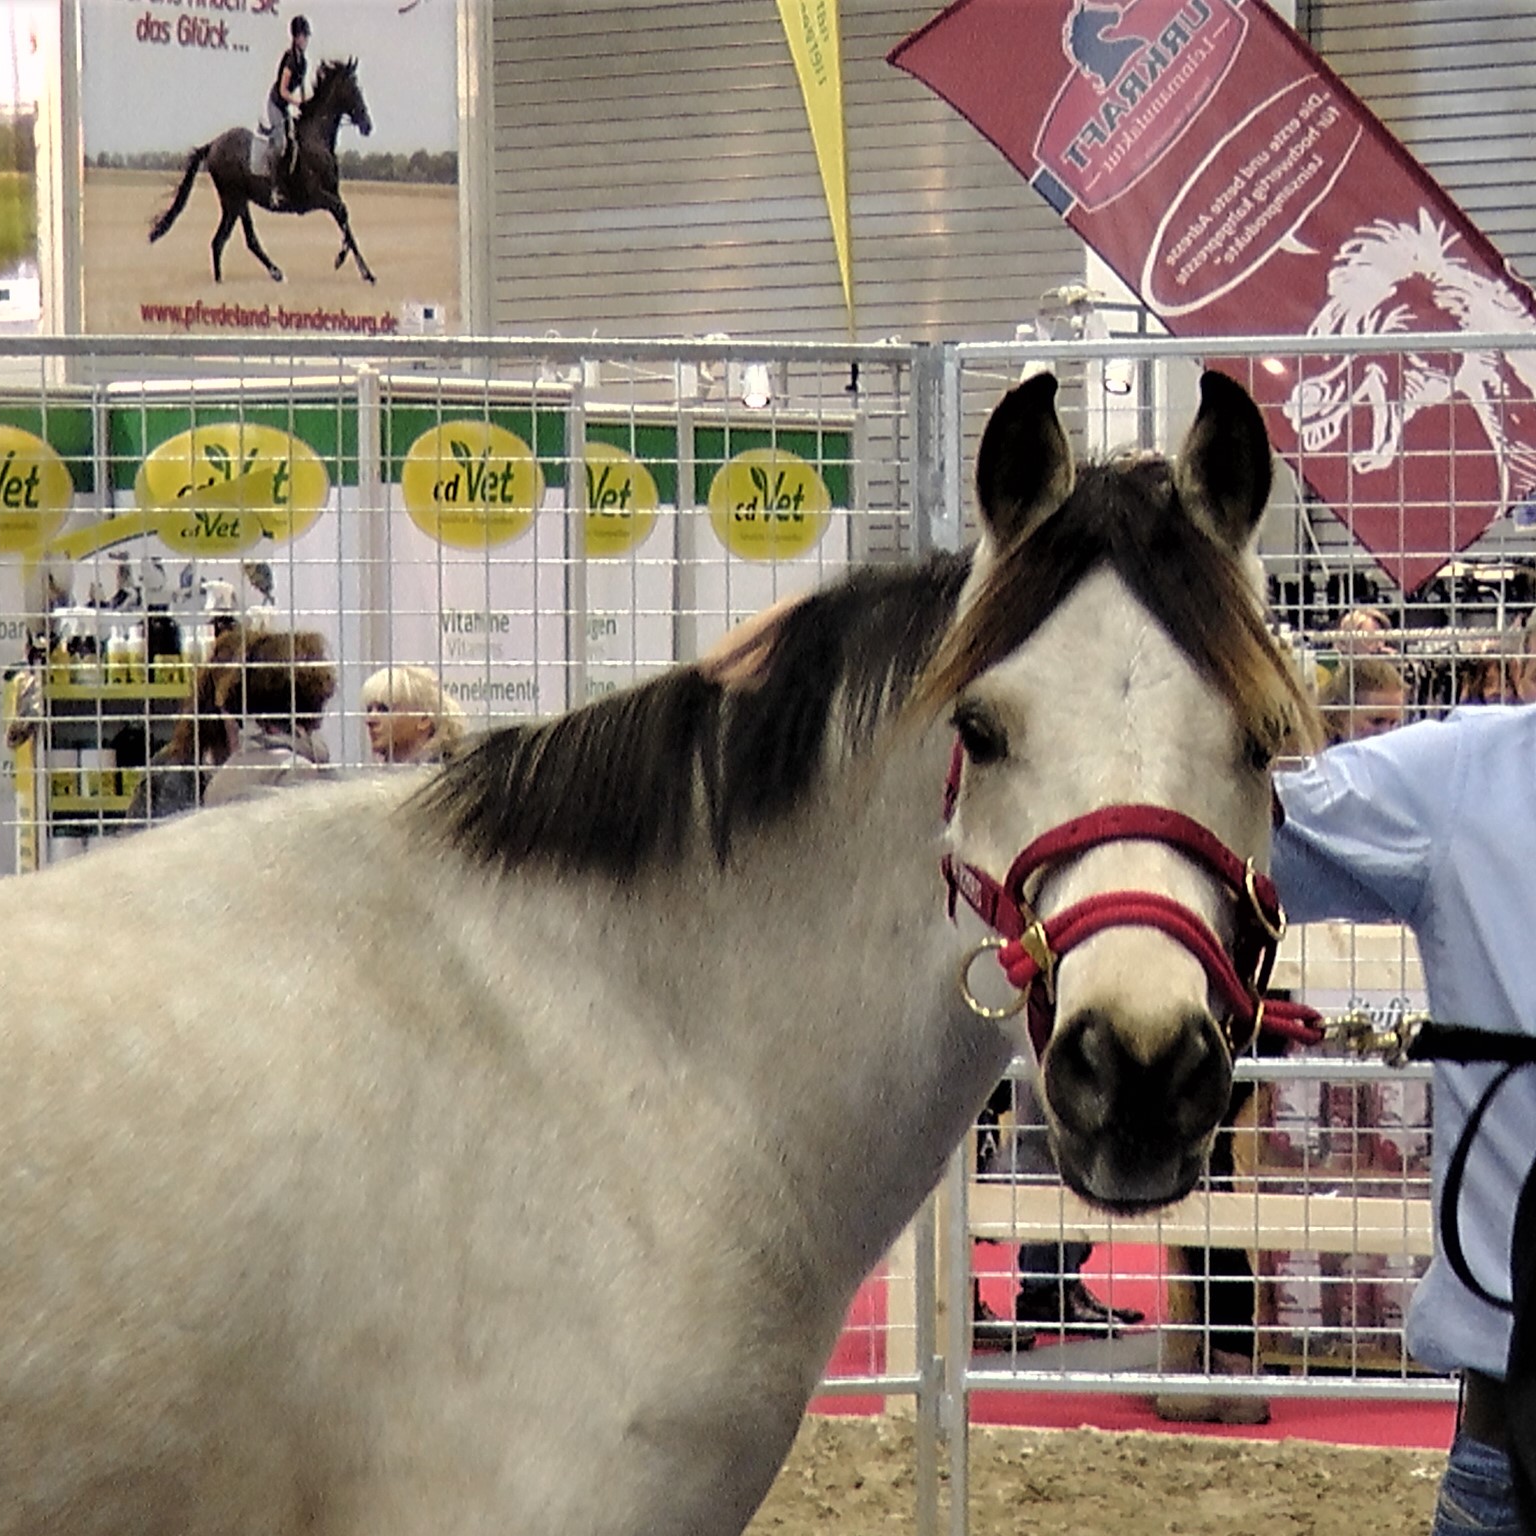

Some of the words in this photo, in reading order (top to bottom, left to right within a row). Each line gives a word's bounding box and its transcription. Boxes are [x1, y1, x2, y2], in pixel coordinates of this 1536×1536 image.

[135, 12, 171, 44] das
[177, 14, 231, 50] Glück
[140, 299, 398, 336] www.pferdeland-brandenburg.de
[433, 440, 514, 504] cdVet
[585, 464, 632, 519] Vet
[734, 466, 805, 522] cdVet
[440, 610, 510, 634] Vitamne
